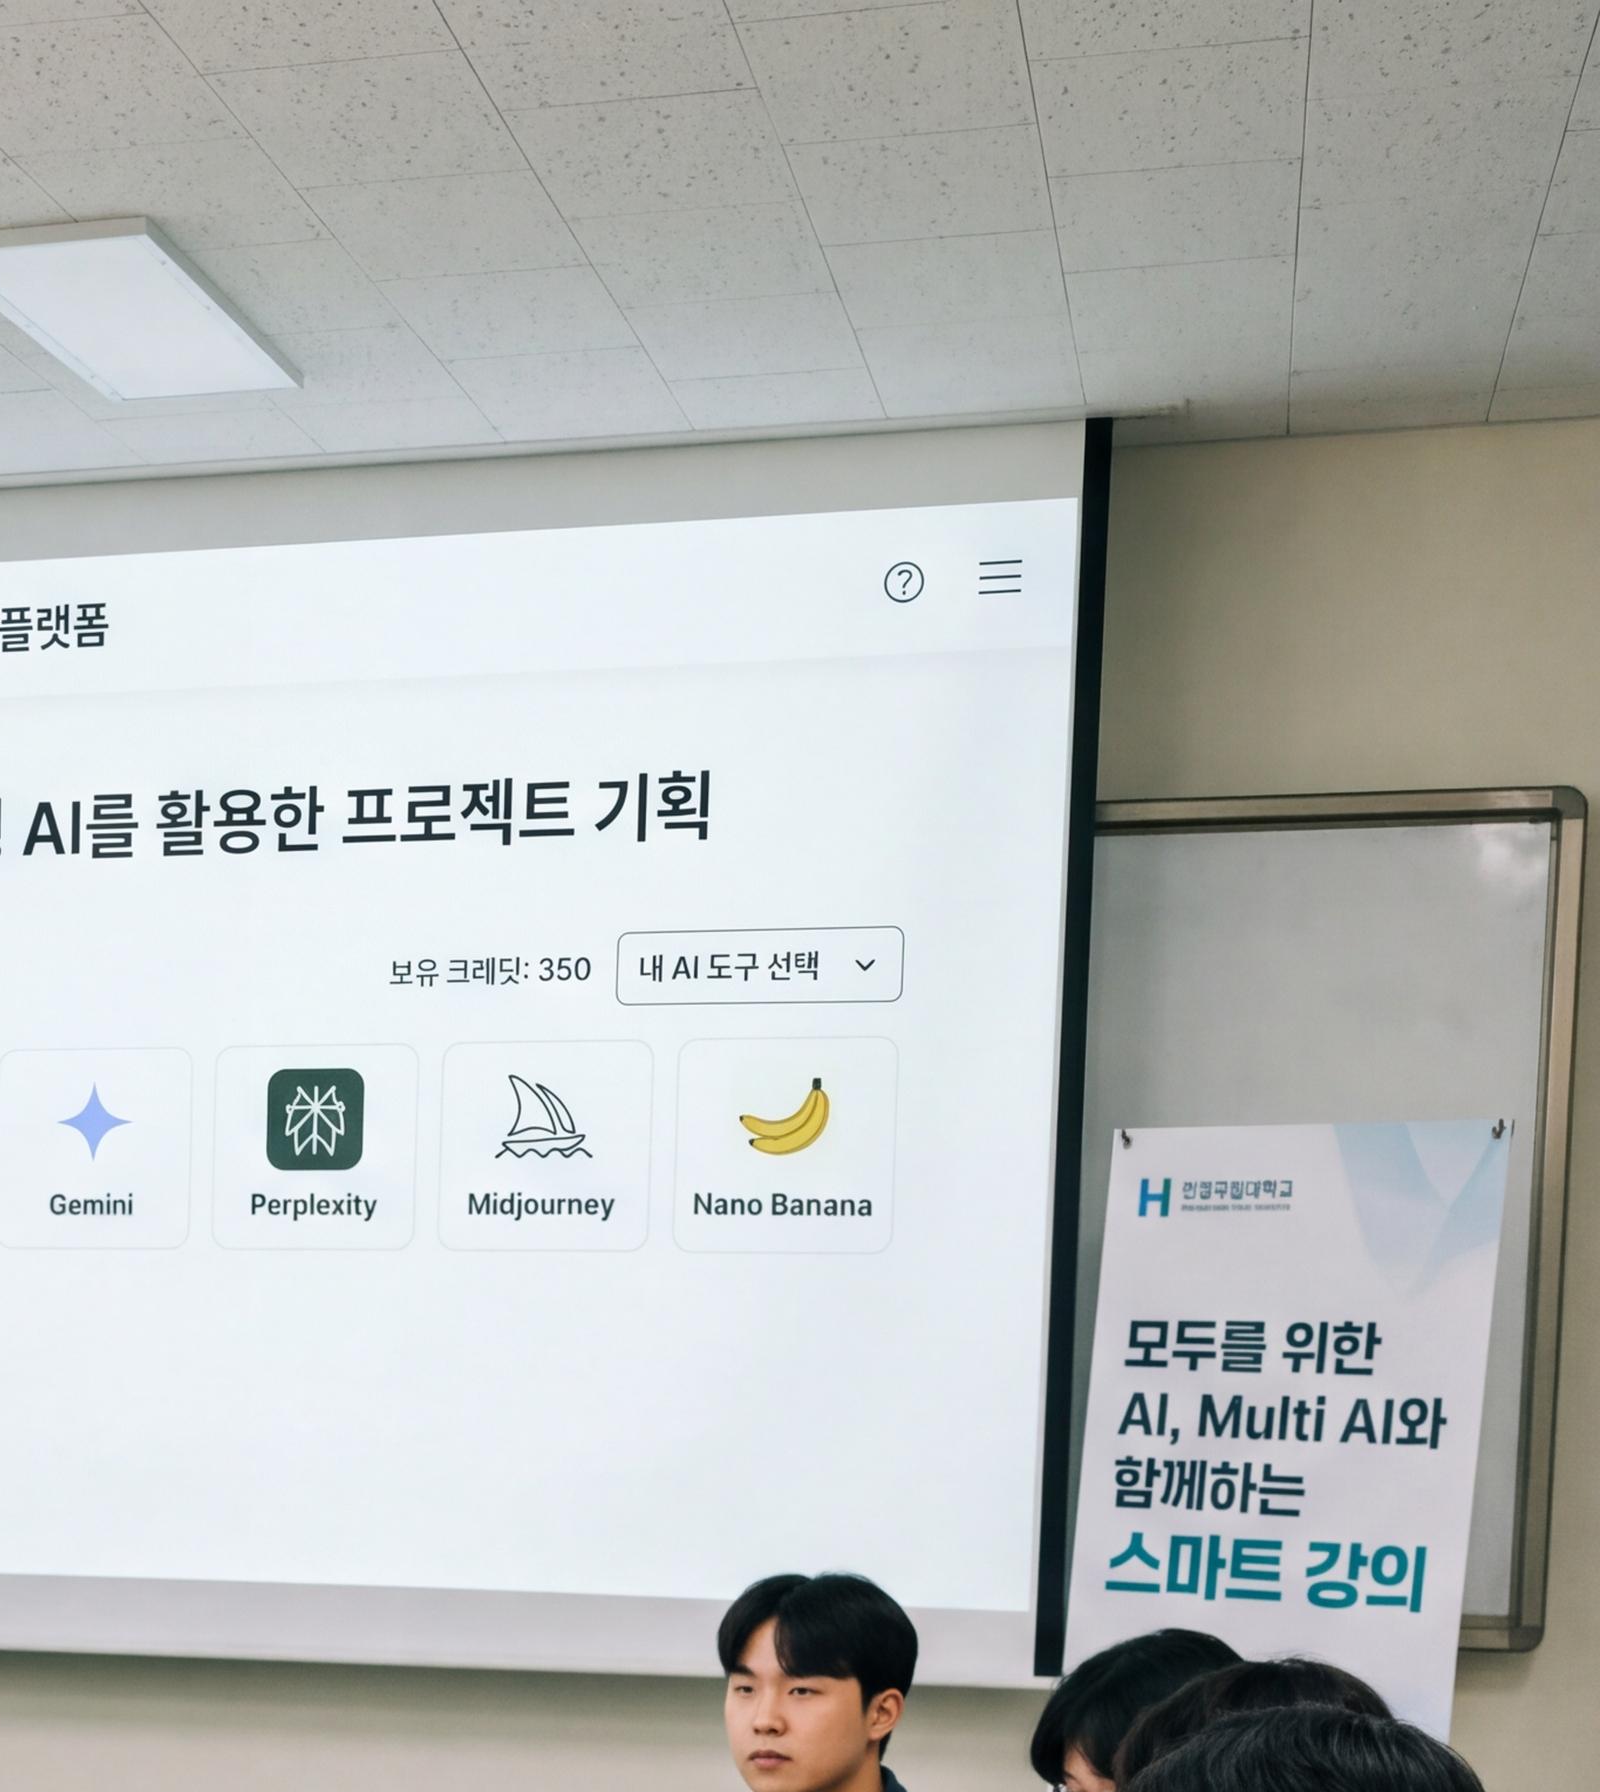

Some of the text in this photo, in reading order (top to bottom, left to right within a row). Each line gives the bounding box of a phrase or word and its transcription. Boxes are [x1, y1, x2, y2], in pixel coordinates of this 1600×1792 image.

[22, 793, 139, 859] AI를
[156, 785, 325, 857] 활용한
[342, 777, 575, 846] 프로젝트
[594, 769, 710, 843] 기획
[389, 956, 592, 988] 보유 크레딧: 350
[639, 950, 819, 983] 내 AI 도구 선택
[49, 1192, 133, 1216] Gemini
[251, 1192, 378, 1222] Perplexity
[468, 1191, 615, 1222] Midjourney
[693, 1192, 873, 1217] Nano Banana
[1124, 1319, 1383, 1376] 모두를 위한
[1117, 1391, 1448, 1450] AI, Multi AI와
[1114, 1455, 1306, 1518] 함께하는
[1104, 1531, 1427, 1614] 스마트 강의
